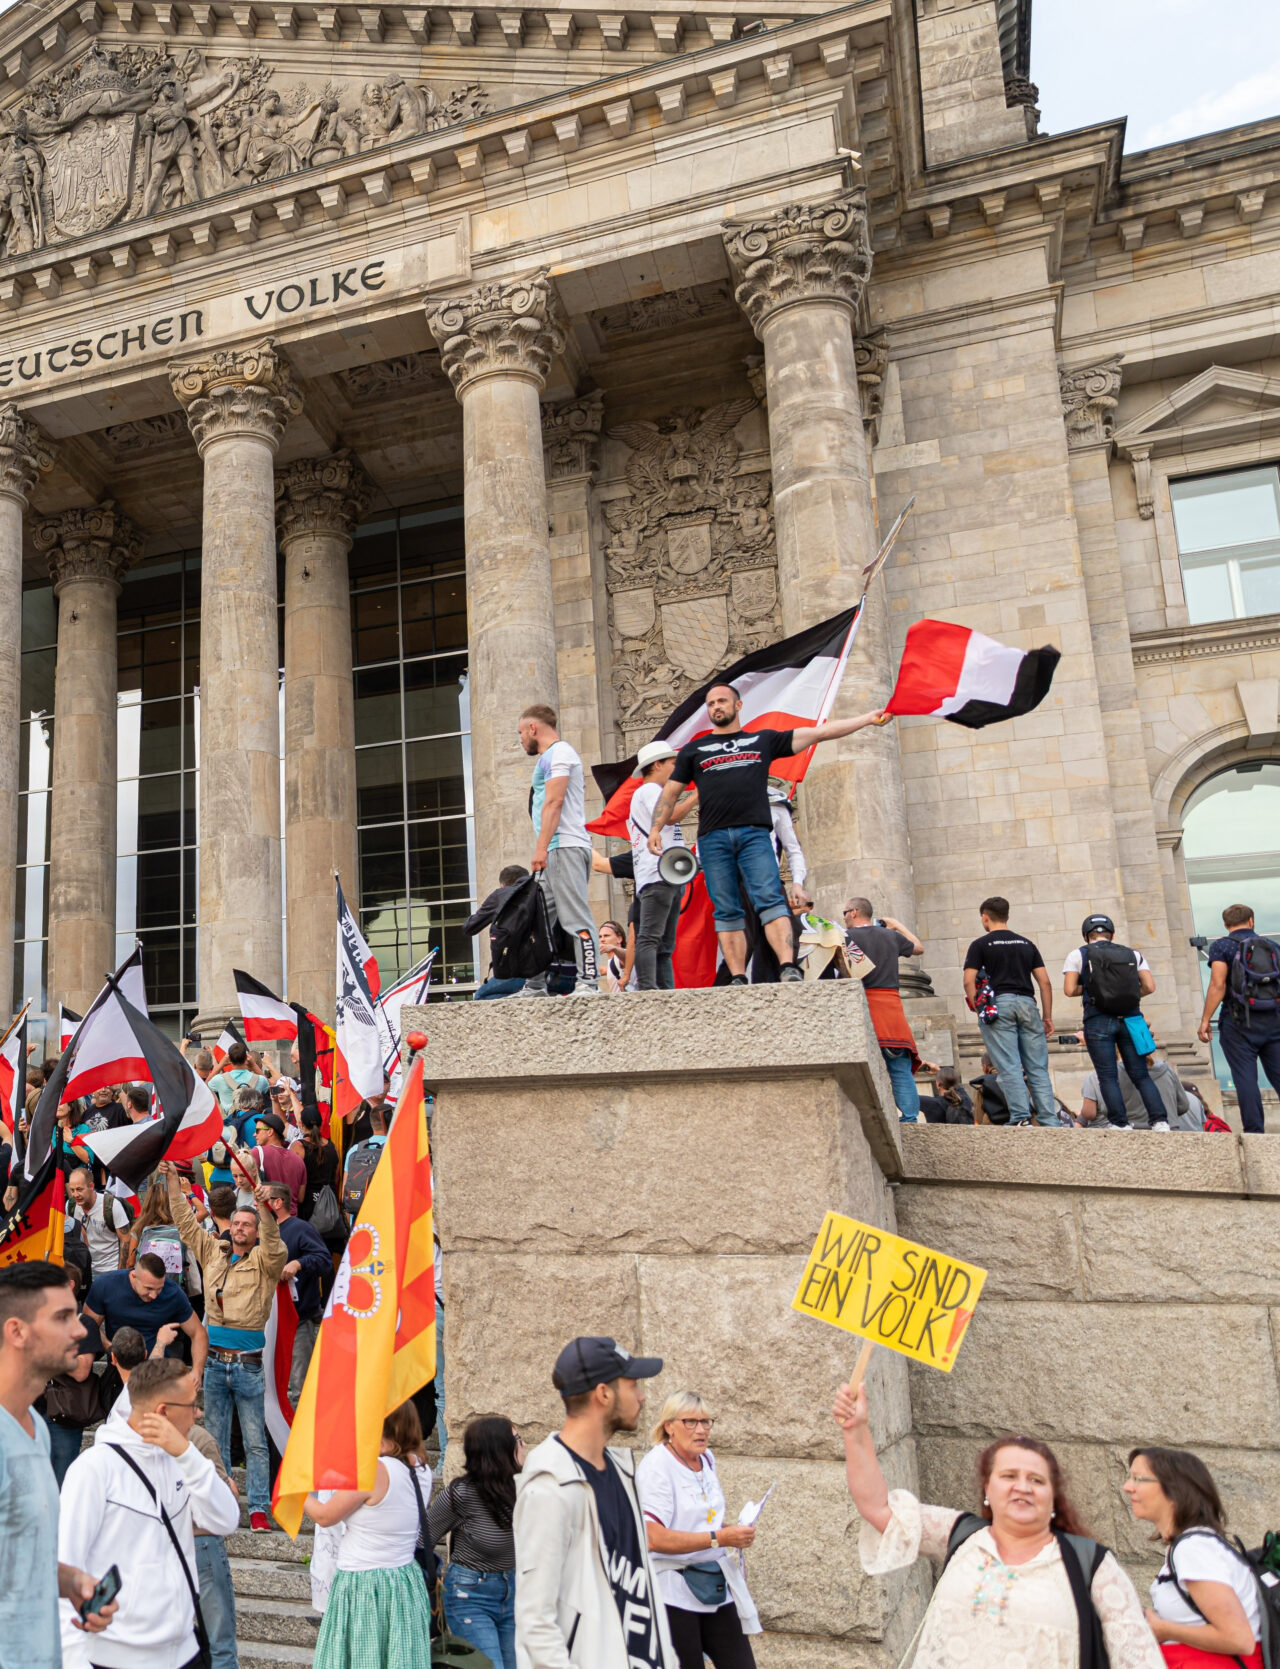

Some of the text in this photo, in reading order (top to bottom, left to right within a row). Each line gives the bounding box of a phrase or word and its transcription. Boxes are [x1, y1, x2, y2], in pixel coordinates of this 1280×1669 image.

[245, 261, 386, 319] VOLKE
[800, 1263, 853, 1318] EIN
[820, 1218, 971, 1310] WIR SIND
